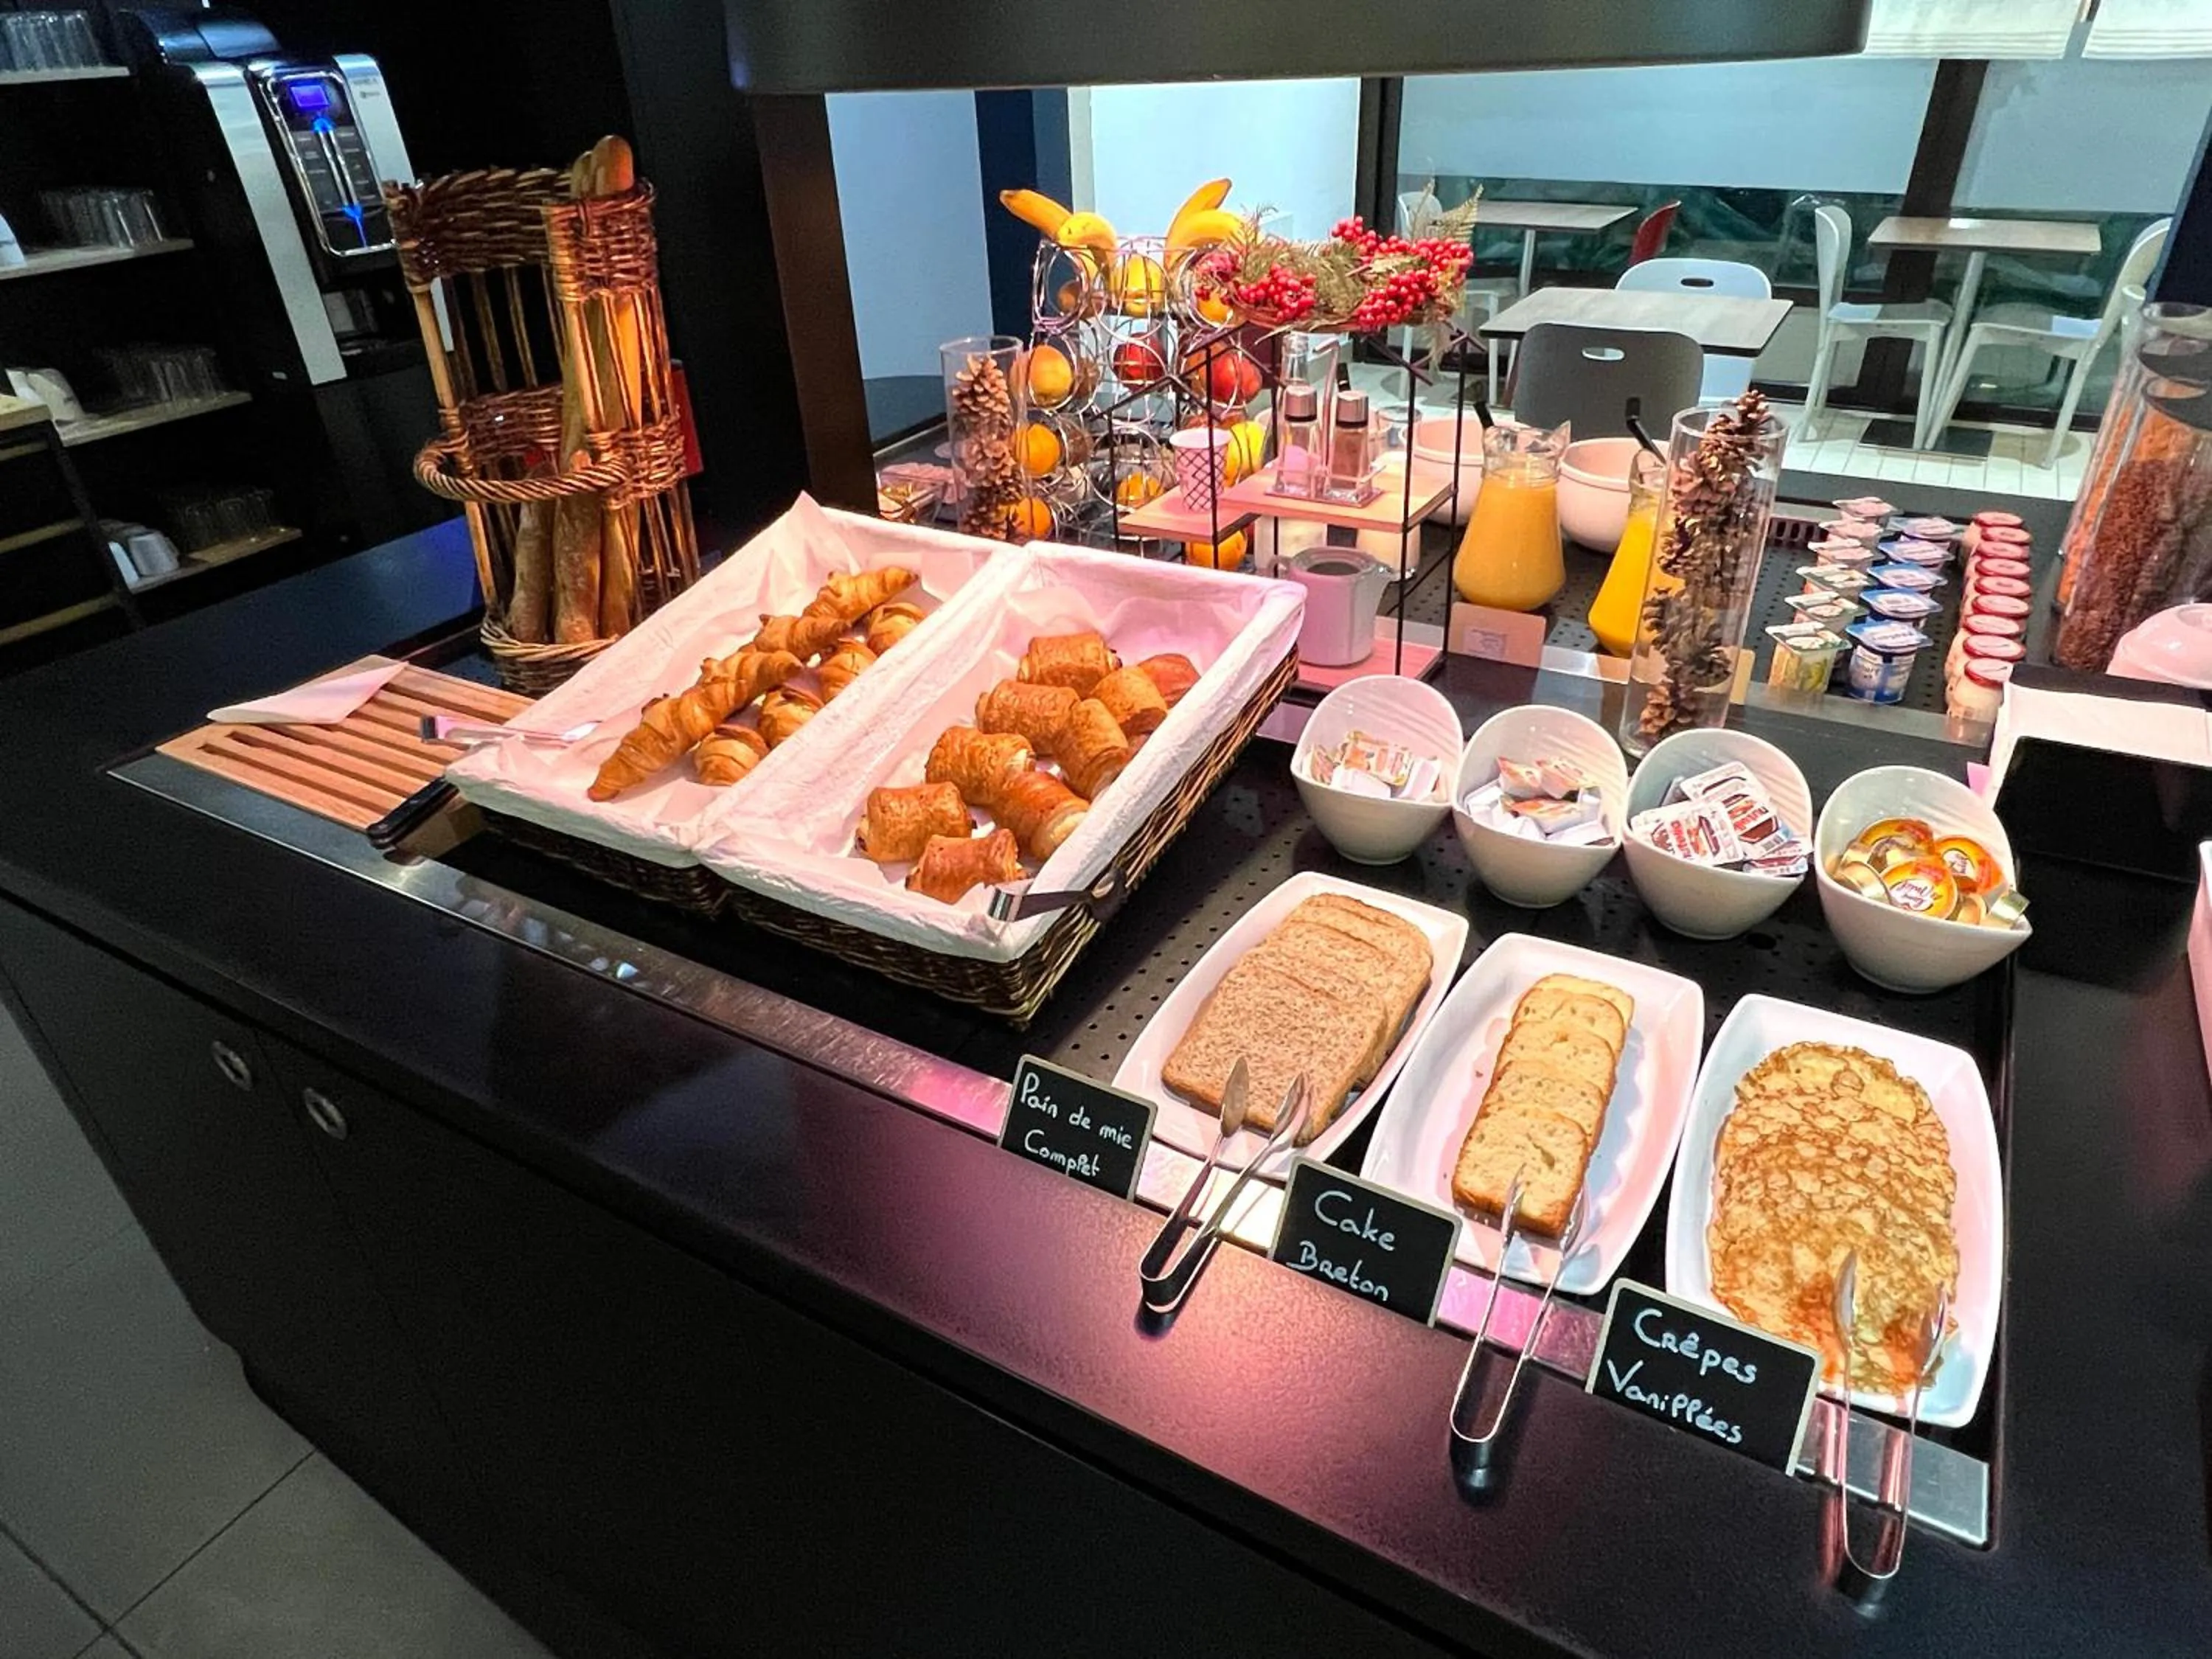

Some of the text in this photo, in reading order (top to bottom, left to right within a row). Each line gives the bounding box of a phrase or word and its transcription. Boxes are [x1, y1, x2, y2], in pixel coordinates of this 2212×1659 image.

[1020, 1071, 1058, 1118] Pain
[1069, 1106, 1091, 1130] de
[1315, 1190, 1395, 1251] Cake
[1285, 1240, 1389, 1301] Breton
[1634, 1307, 1758, 1383] Crêpes
